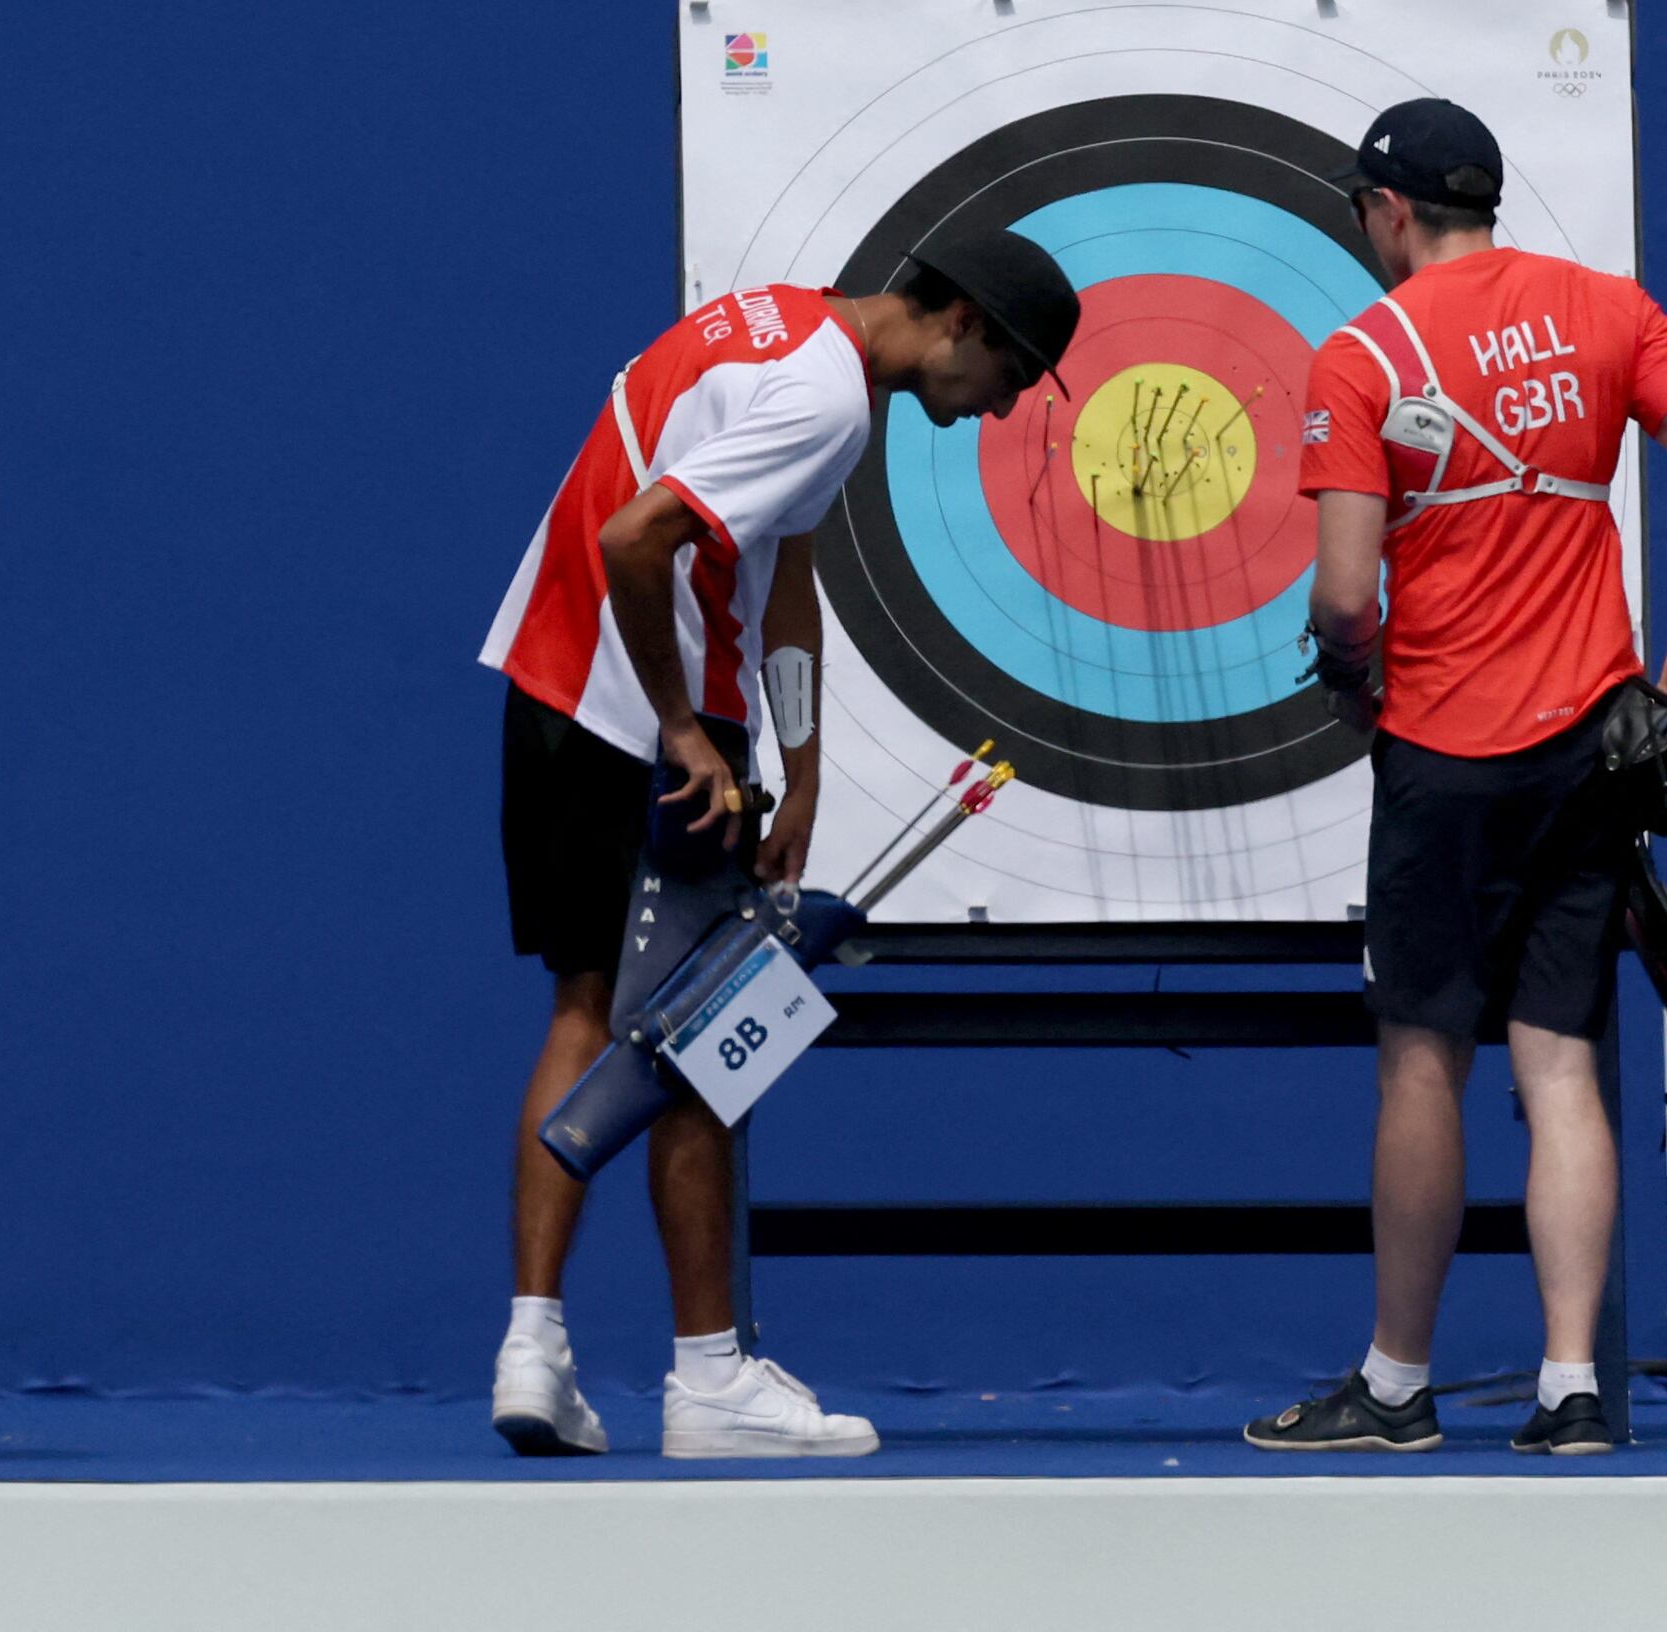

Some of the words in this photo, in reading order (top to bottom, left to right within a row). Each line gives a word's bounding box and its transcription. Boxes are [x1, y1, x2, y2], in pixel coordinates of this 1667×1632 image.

[1537, 71, 1569, 79] PARIS
[1573, 71, 1602, 79] 2024
[1468, 314, 1576, 377] HALL
[1494, 371, 1585, 436] GBR
[718, 1015, 768, 1071] 8B
